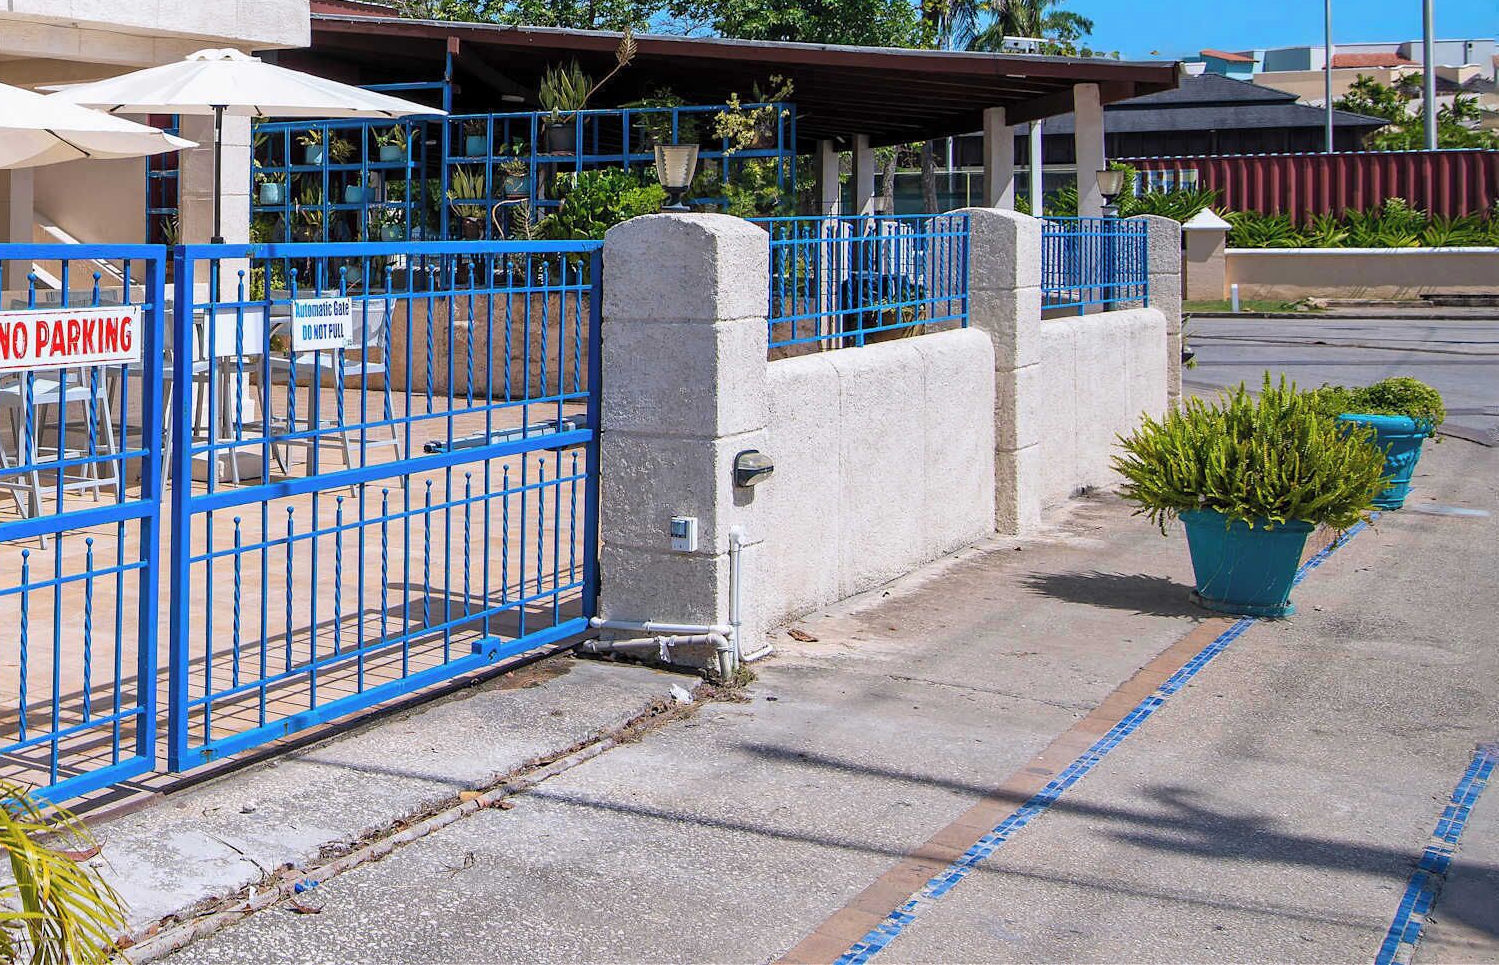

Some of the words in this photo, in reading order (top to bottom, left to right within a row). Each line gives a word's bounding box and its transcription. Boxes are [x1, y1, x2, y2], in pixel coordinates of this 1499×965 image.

[295, 301, 332, 318] Automatic
[334, 300, 349, 316] Gate
[35, 316, 132, 358] PARKING
[303, 324, 312, 340] DO
[313, 323, 327, 340] NOT
[328, 323, 344, 339] PULL
